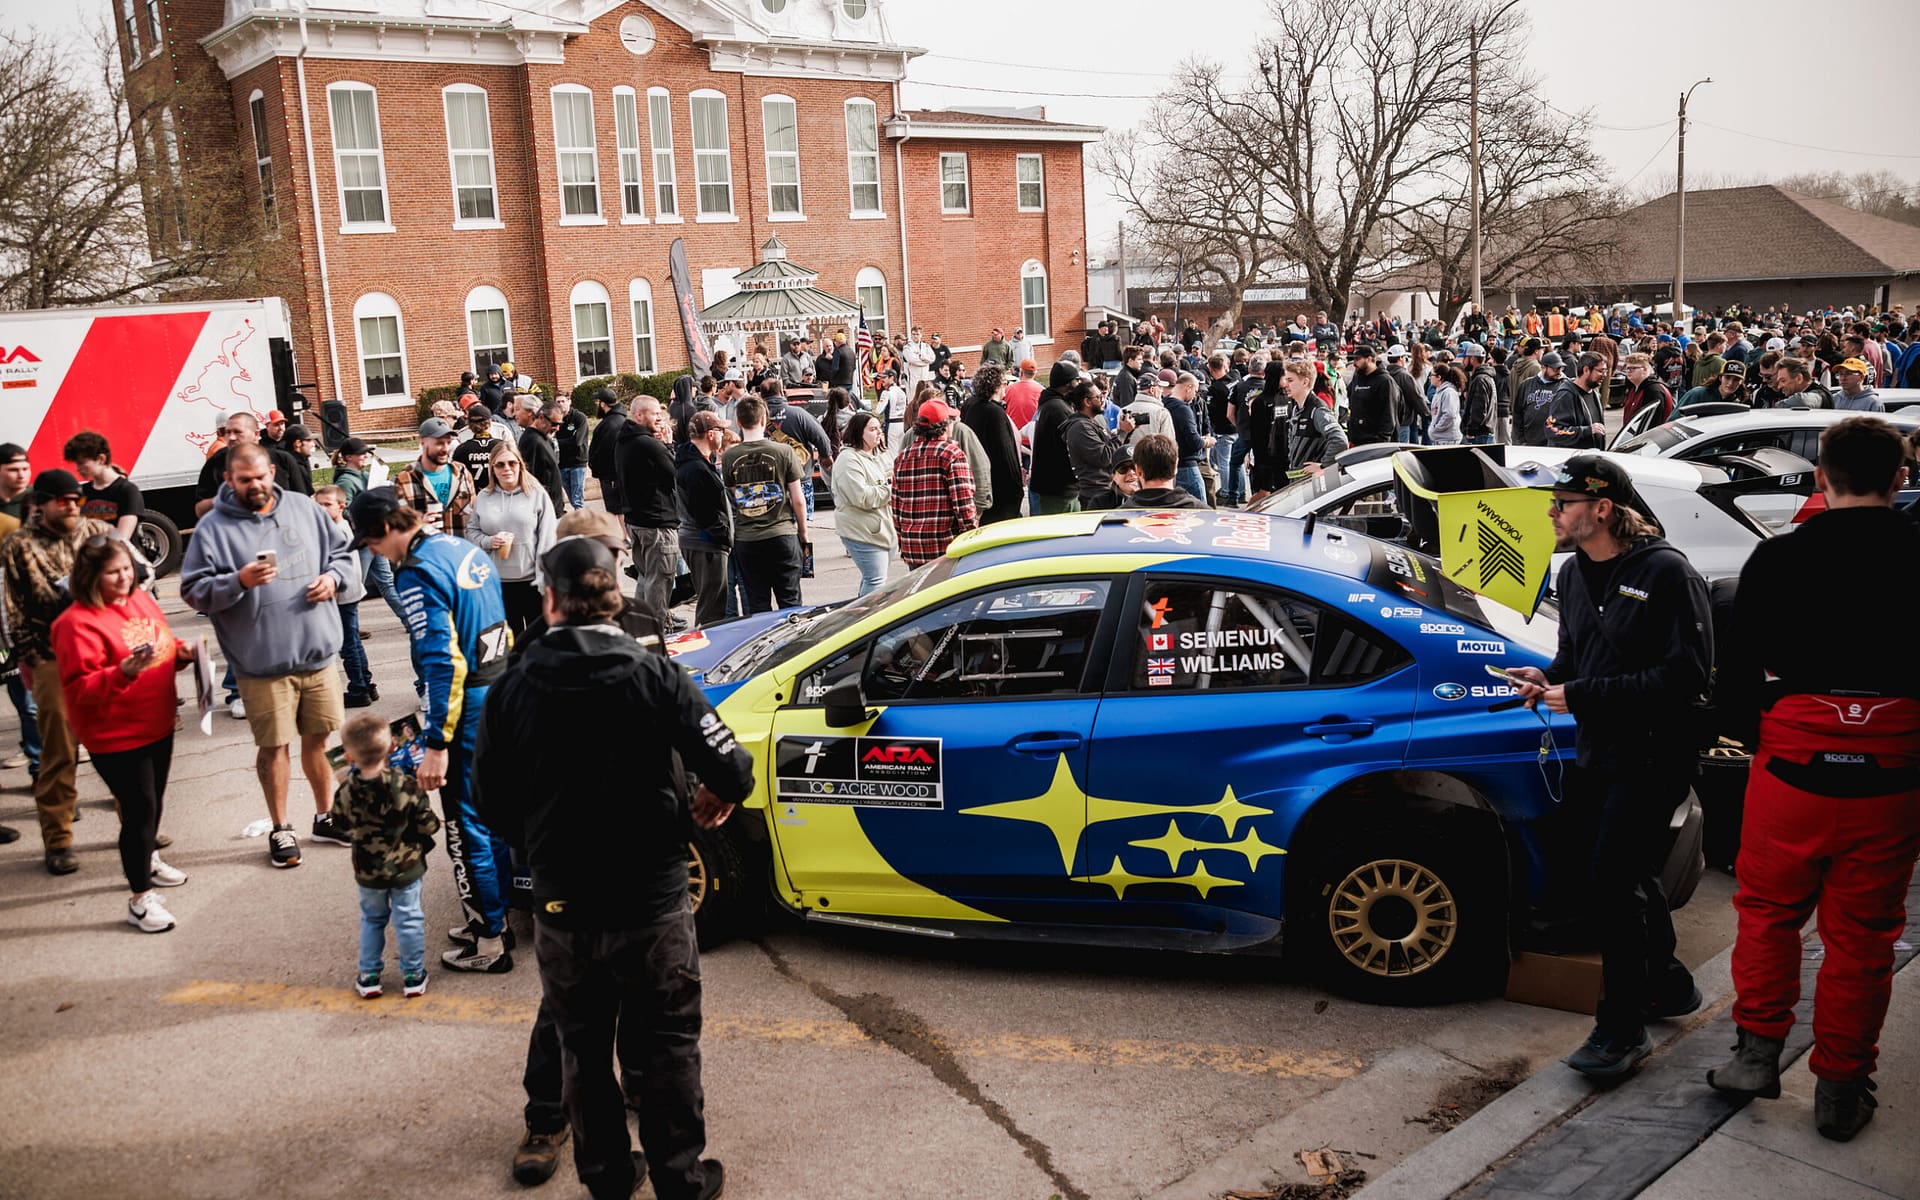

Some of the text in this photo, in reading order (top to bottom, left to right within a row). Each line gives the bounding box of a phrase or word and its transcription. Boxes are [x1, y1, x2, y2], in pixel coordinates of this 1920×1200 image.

[1477, 500, 1523, 543] YOKOHAMA
[1619, 584, 1649, 598] SUBARU
[1151, 597, 1173, 629] 1
[1420, 623, 1465, 635] sparco
[1180, 628, 1285, 649] SEMENUK
[1460, 642, 1503, 652] MOTUL
[1181, 652, 1285, 673] WILLIAMS
[1471, 686, 1520, 697] SUBA
[804, 741, 826, 774] 1
[861, 746, 935, 763] ARA
[1824, 753, 1865, 763] sparco
[809, 781, 929, 797] 100 ACRE WOOD
